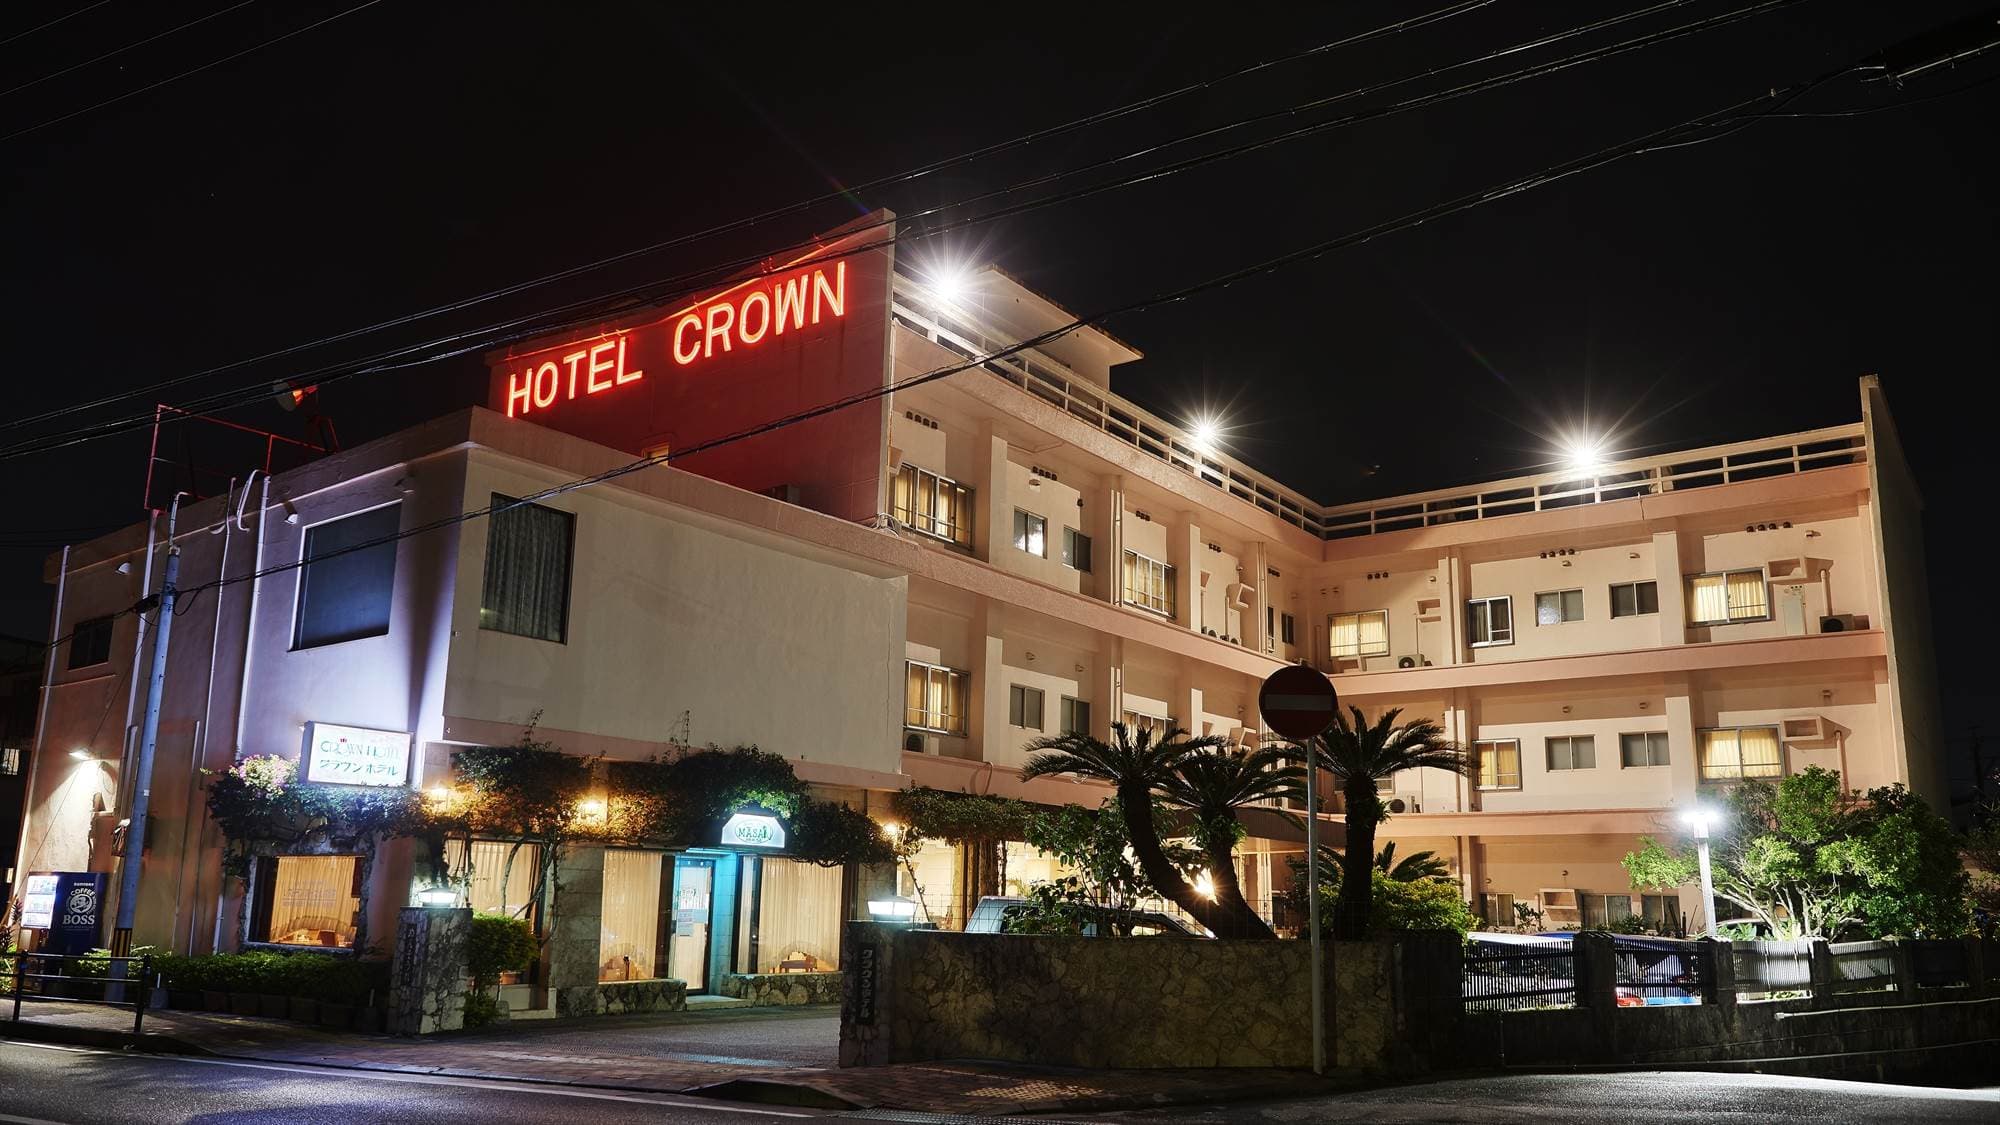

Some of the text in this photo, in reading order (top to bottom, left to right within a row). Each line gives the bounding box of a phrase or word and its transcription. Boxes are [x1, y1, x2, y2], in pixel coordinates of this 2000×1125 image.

[507, 261, 846, 418] HOTEL CROWN
[70, 887, 97, 897] COFFEE
[62, 914, 96, 925] BOSS
